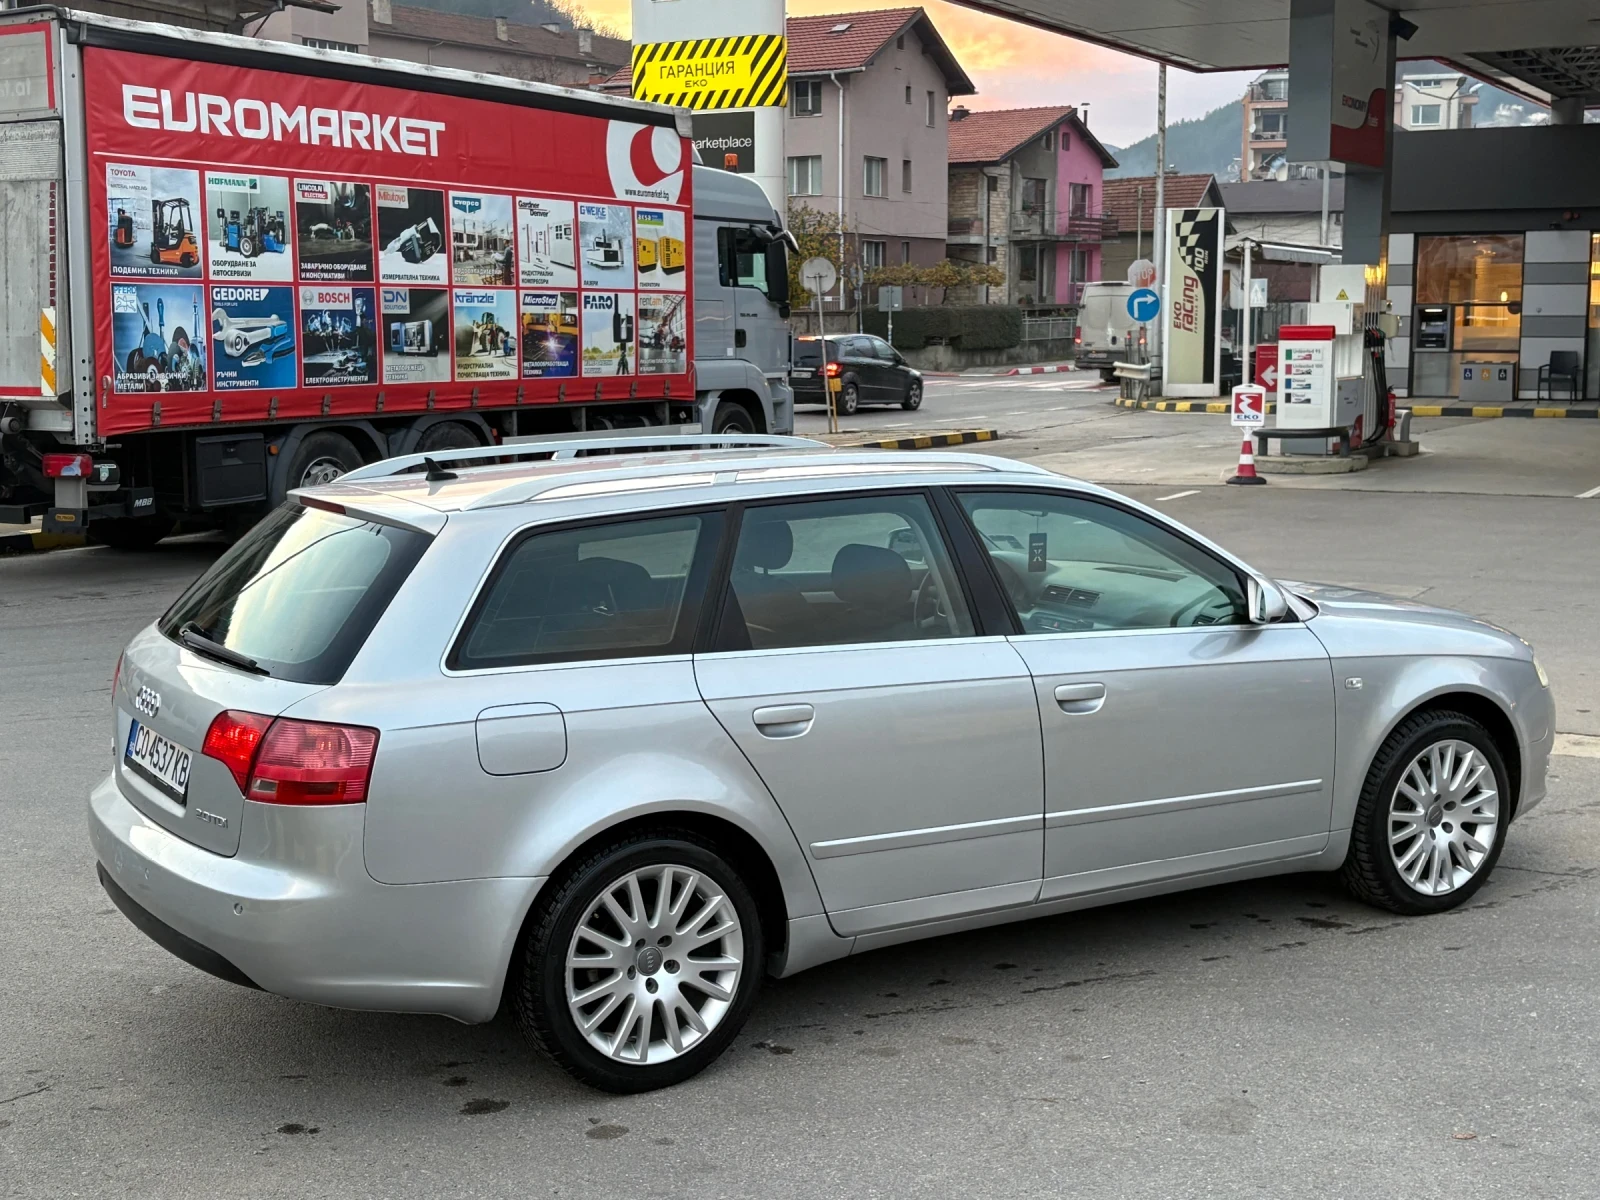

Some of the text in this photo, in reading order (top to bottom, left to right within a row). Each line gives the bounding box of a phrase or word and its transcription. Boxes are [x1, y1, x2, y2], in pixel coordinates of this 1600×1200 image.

[660, 61, 735, 79] ГАРАНЦИЯ
[685, 79, 707, 88] EKO
[122, 84, 446, 157] EUROMARKET
[110, 169, 136, 178] TOYOTA
[208, 177, 247, 187] HOFMANN
[298, 184, 323, 192] LINCOLN
[624, 189, 670, 201] www.euromarket.bg
[454, 199, 479, 207] evapco
[518, 200, 540, 209] Gardner
[212, 260, 249, 268] ОБОРУДВАНЕ
[1195, 248, 1205, 272] 100
[112, 266, 179, 276] ПОДЕМНА ТЕХНИКА
[300, 262, 367, 272] ЗАВАРЪЧНО ОБОРУДВАНЕ
[212, 269, 252, 277] АВТОСЕРВИЗИ
[306, 272, 345, 280] КОНСУМАТИВИ
[212, 288, 262, 301] GEDORE
[318, 293, 350, 304] BOSCH
[382, 290, 407, 303] DN
[455, 292, 494, 303] kränzle
[524, 296, 556, 305] MicroStep
[584, 295, 613, 310] FARO
[1182, 276, 1198, 333] racing
[1174, 301, 1182, 330] EKO
[117, 372, 151, 380] АБРАЗИВИ
[216, 371, 237, 379] РЪЧНИ
[305, 375, 369, 384] ЕЛЕКТРОИНСТРУМЕНТИ
[117, 382, 144, 390] МЕТАЛИ
[216, 380, 259, 388] ИНСТРУМЕНТИ
[134, 498, 153, 507] MBB
[135, 726, 189, 786] CO 4537 KB
